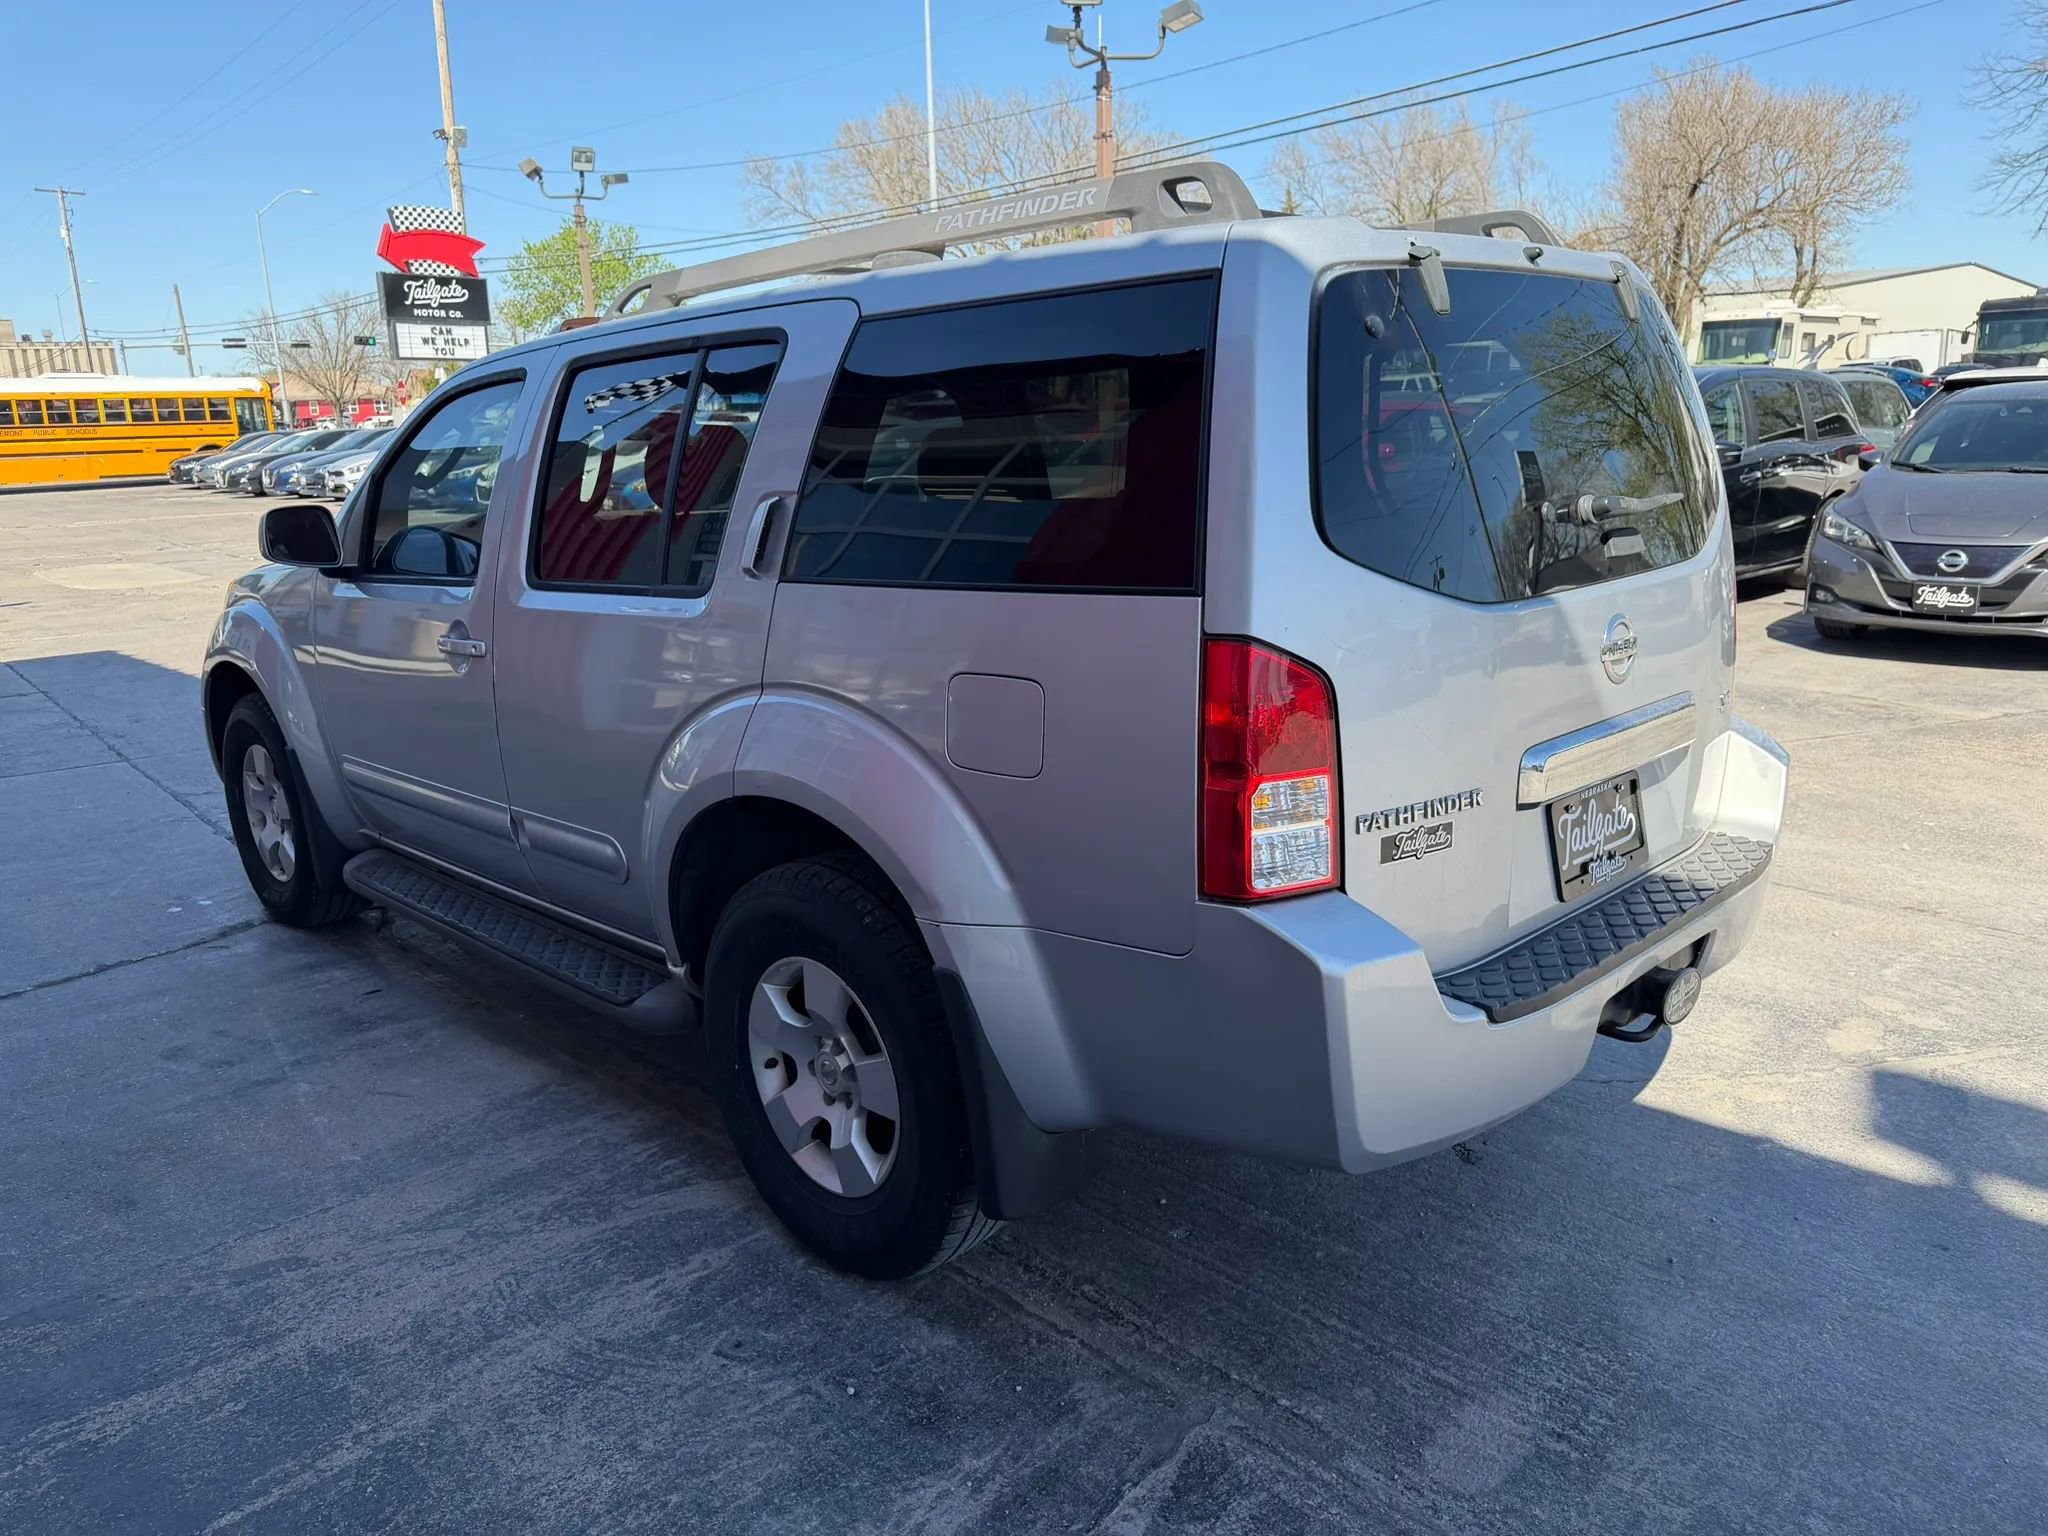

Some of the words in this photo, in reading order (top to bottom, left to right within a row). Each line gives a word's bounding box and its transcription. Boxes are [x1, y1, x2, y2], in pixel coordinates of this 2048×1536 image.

[934, 186, 1098, 234] PATHFINDER
[404, 278, 469, 307] Tailgate
[413, 308, 446, 318] MOTOR
[449, 309, 464, 318] CO.
[420, 336, 437, 346] WE
[443, 337, 470, 347] HELP
[430, 326, 453, 336] CAN
[433, 347, 455, 356] YOU
[66, 428, 98, 436] SCHOOLS
[1915, 585, 1975, 608] Tailgate
[1580, 782, 1612, 800] NEBRASKA
[1355, 787, 1485, 835] PATHFINDER
[1392, 824, 1451, 860] Tailgate
[1558, 794, 1636, 871] Tailgate
[1588, 854, 1627, 886] Tailgate
